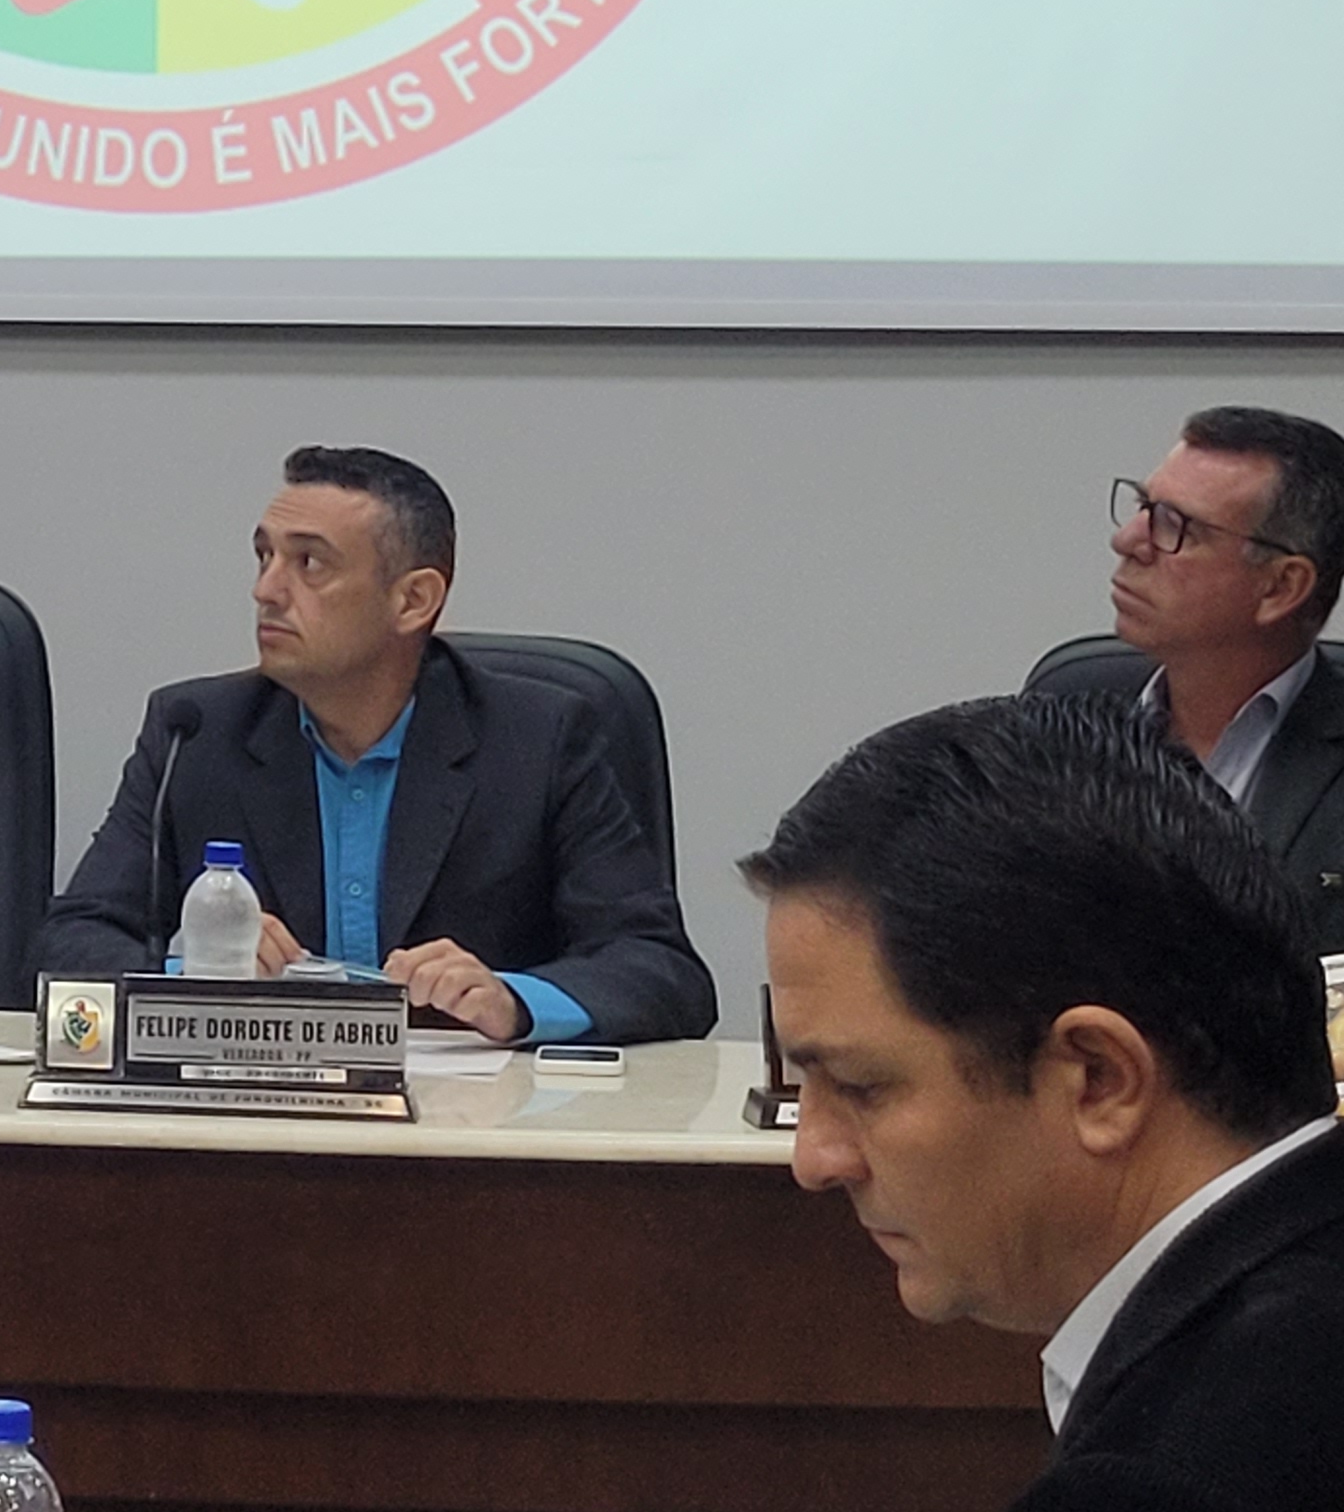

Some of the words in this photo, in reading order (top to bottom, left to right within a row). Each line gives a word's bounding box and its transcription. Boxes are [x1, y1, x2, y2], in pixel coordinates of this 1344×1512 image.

[212, 110, 251, 185] É
[273, 72, 436, 175] MAIS
[135, 1014, 198, 1040] FELIPE
[206, 1017, 294, 1043] DORDETE
[302, 1020, 326, 1044] DE
[333, 1022, 399, 1046] ABREU
